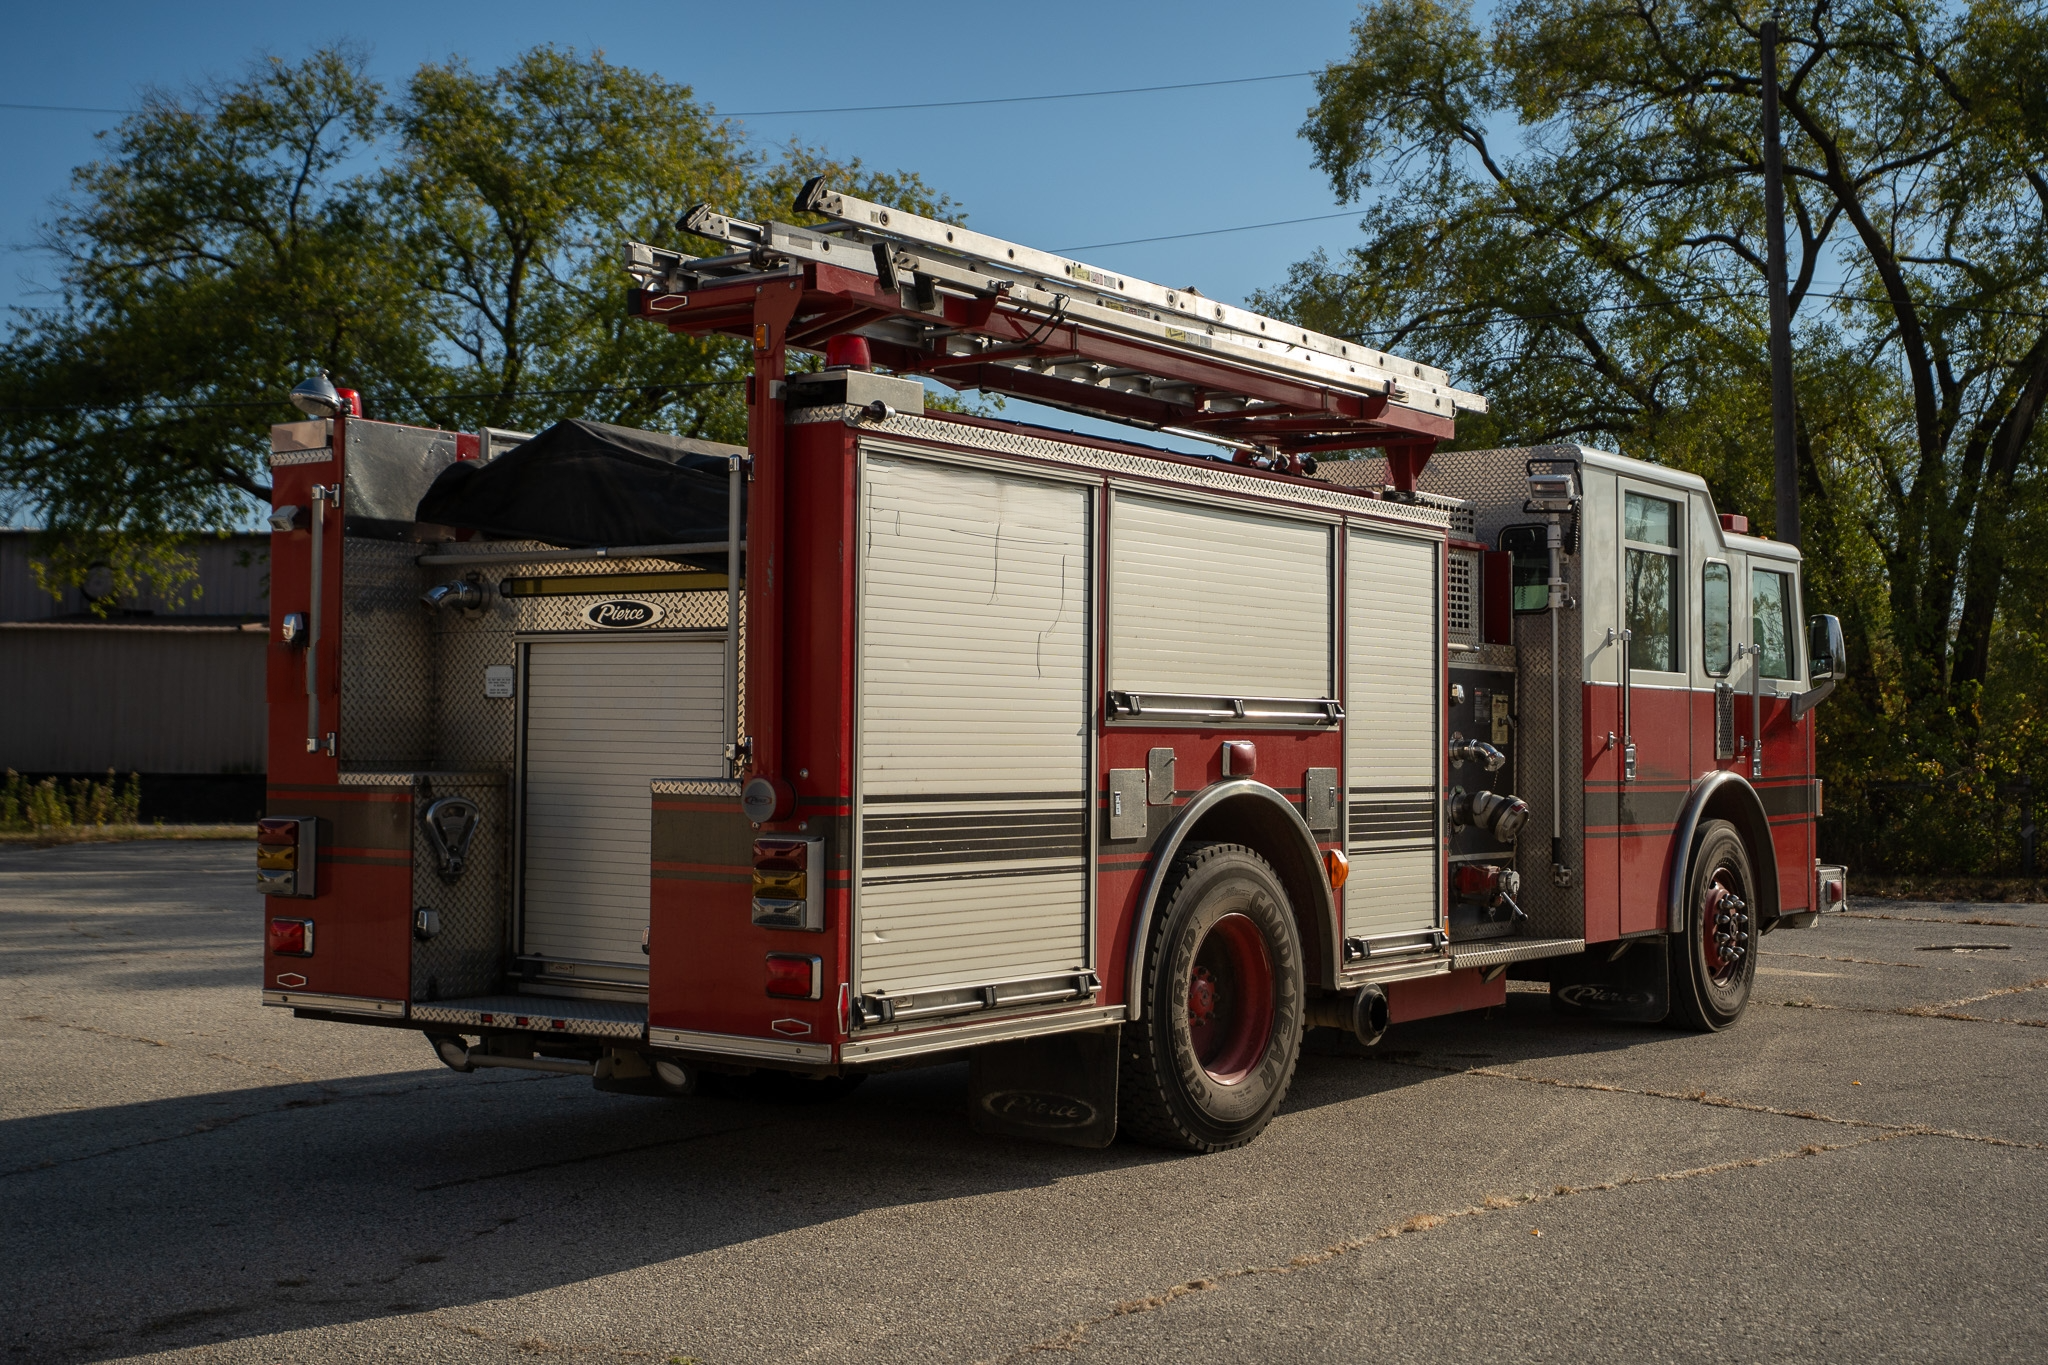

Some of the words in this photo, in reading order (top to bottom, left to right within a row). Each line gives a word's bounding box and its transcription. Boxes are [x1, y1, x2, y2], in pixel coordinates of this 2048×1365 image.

[596, 603, 645, 624] Pierce
[1173, 928, 1197, 1007] RSD
[1249, 890, 1297, 1092] GOODYEAR
[1574, 986, 1639, 1002] Pierce
[1002, 1094, 1080, 1118] Pierce
